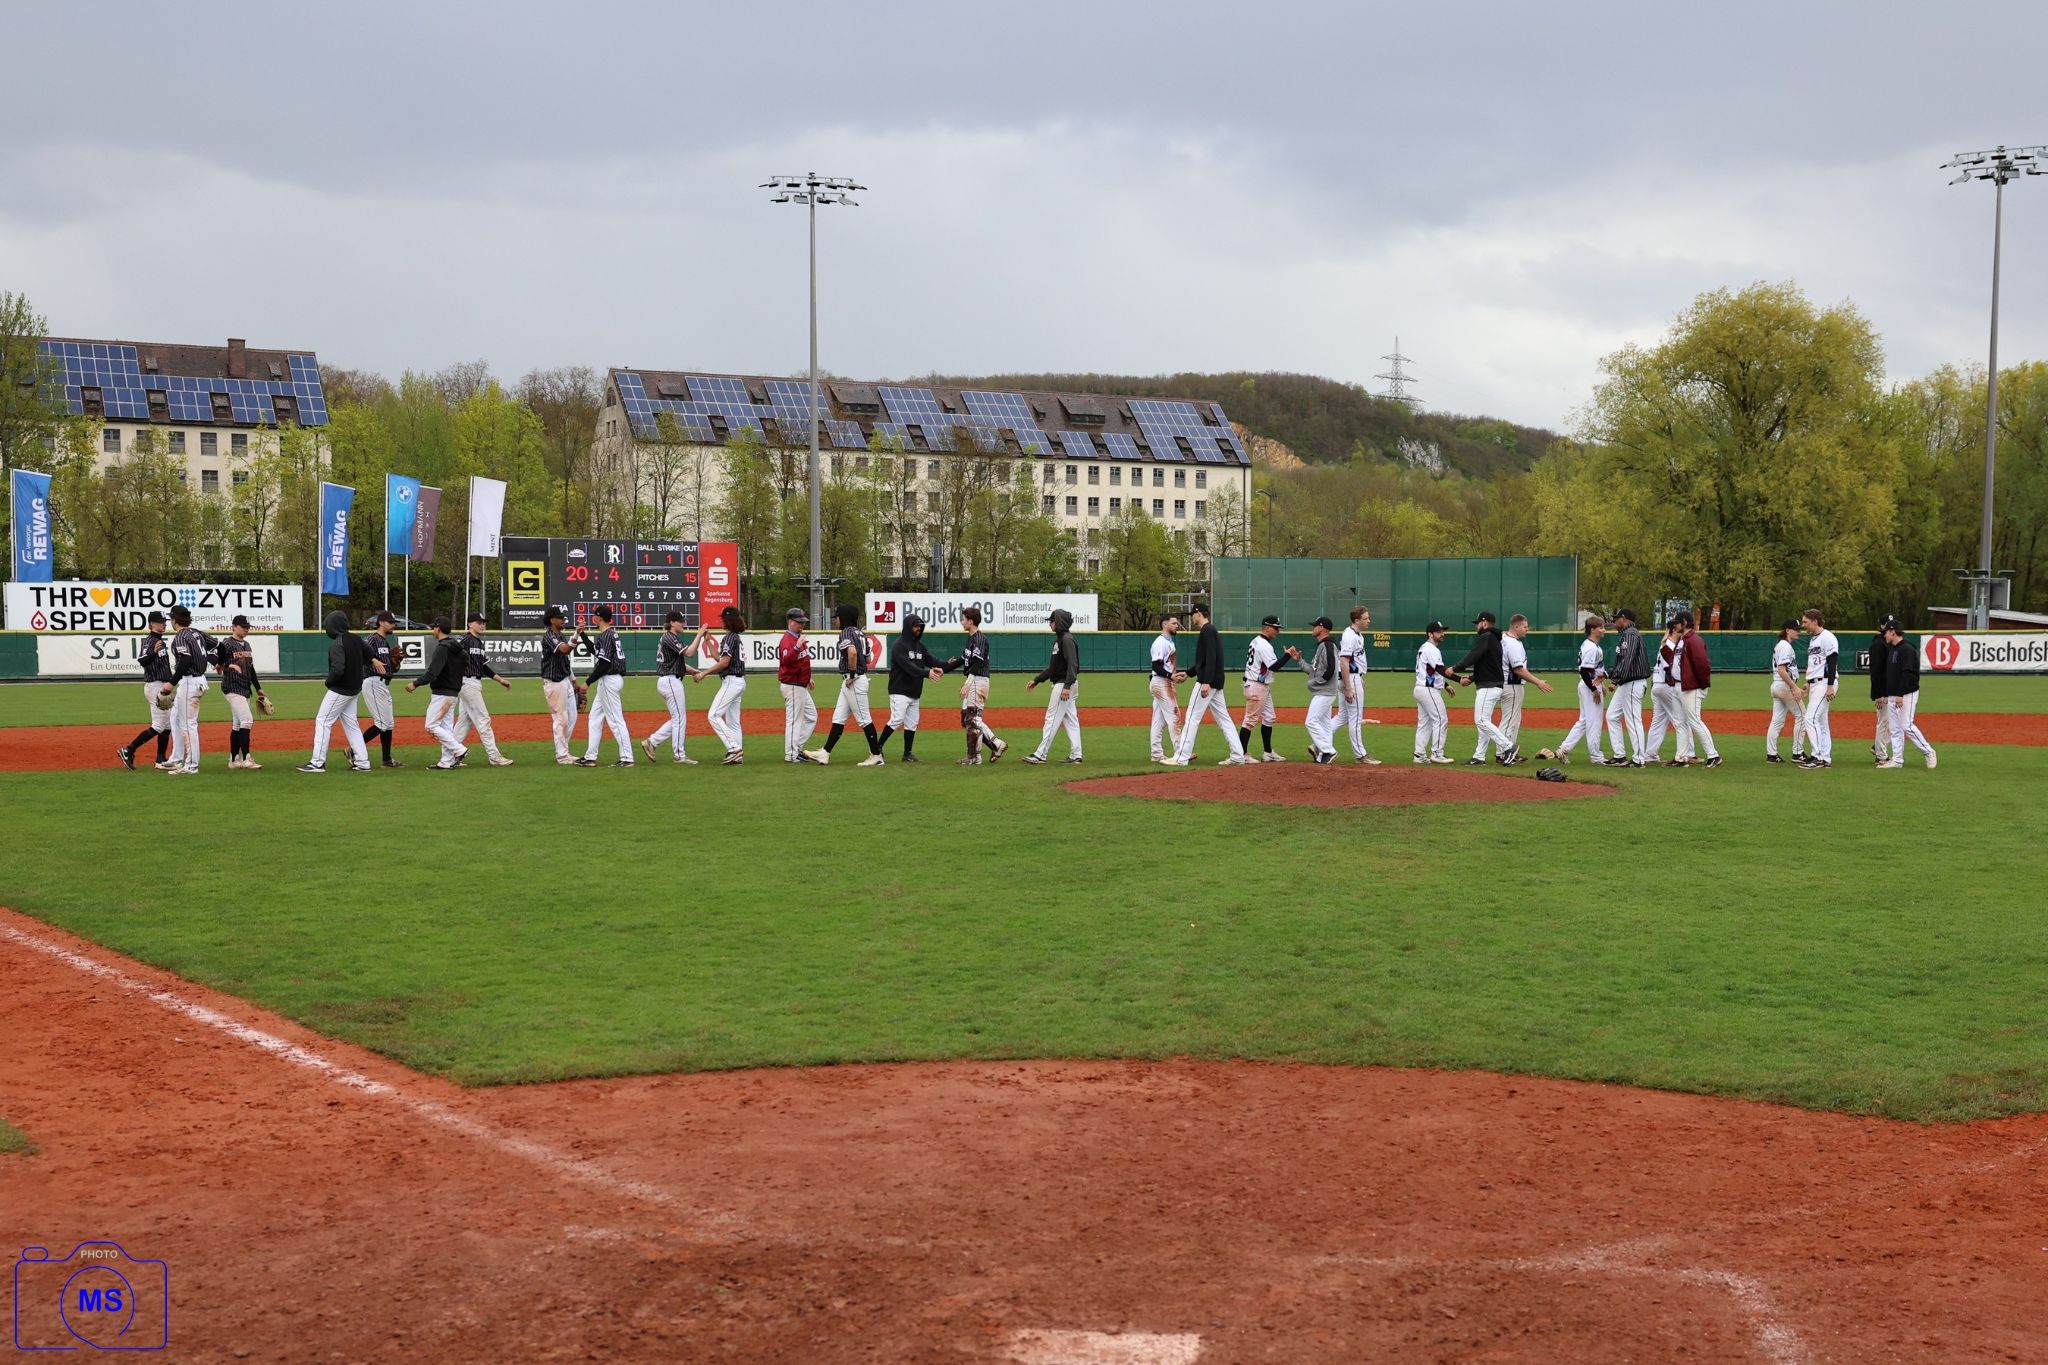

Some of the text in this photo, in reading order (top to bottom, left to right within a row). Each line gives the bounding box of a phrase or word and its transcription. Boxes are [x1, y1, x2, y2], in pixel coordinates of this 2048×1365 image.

[31, 498, 47, 560] REWAG
[332, 510, 346, 567] REWAG
[644, 554, 694, 564] 1 1 0
[566, 566, 588, 581] 20
[608, 567, 619, 581] 4
[685, 573, 696, 582] 15
[592, 591, 598, 599] 2
[607, 591, 612, 599] 3
[578, 604, 584, 612] 0
[620, 604, 627, 612] 0
[635, 604, 641, 612] 5
[1006, 601, 1052, 611] Datenschutz
[257, 614, 284, 622] retten:
[884, 612, 894, 621] 29
[903, 601, 963, 627] Projekt
[1006, 614, 1089, 624] Informationrheit
[50, 611, 147, 631] SPEND
[622, 616, 626, 624] 1
[635, 615, 642, 624] 0
[91, 638, 120, 660] SG
[481, 641, 542, 652] EINSAM
[753, 640, 841, 661] Biscshof
[1935, 638, 1951, 666] B
[510, 656, 533, 664] Region
[91, 663, 102, 671] Ein
